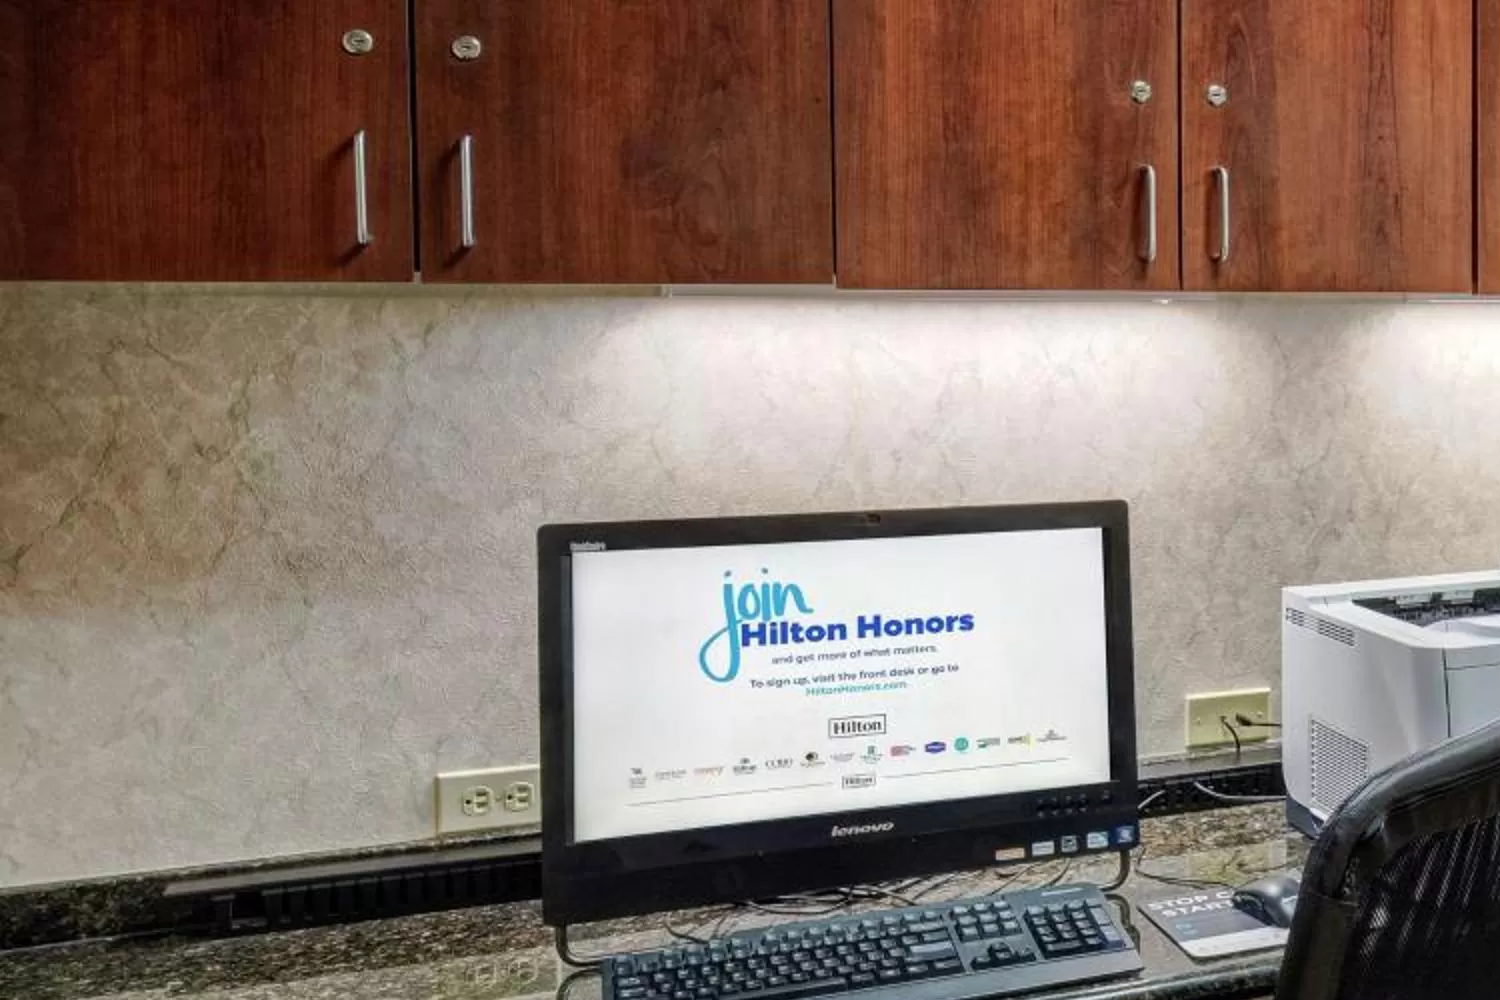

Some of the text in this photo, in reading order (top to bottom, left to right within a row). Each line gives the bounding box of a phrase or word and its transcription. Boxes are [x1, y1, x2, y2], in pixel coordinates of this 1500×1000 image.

[699, 568, 814, 683] join
[741, 612, 975, 647] Hilton Honors
[772, 651, 793, 664] and
[795, 652, 814, 664] get
[817, 651, 847, 662] more
[850, 649, 861, 659] of
[864, 647, 890, 658] what
[750, 679, 764, 689] To
[767, 677, 790, 689] sign
[812, 673, 835, 683] visit
[838, 671, 857, 681] the
[859, 669, 886, 680] front
[889, 666, 915, 677] desk
[918, 667, 929, 675] or
[931, 666, 945, 675] go
[947, 664, 959, 672] to
[833, 720, 882, 736] Hilton
[831, 821, 895, 837] lenovo
[1148, 895, 1208, 909] STOP
